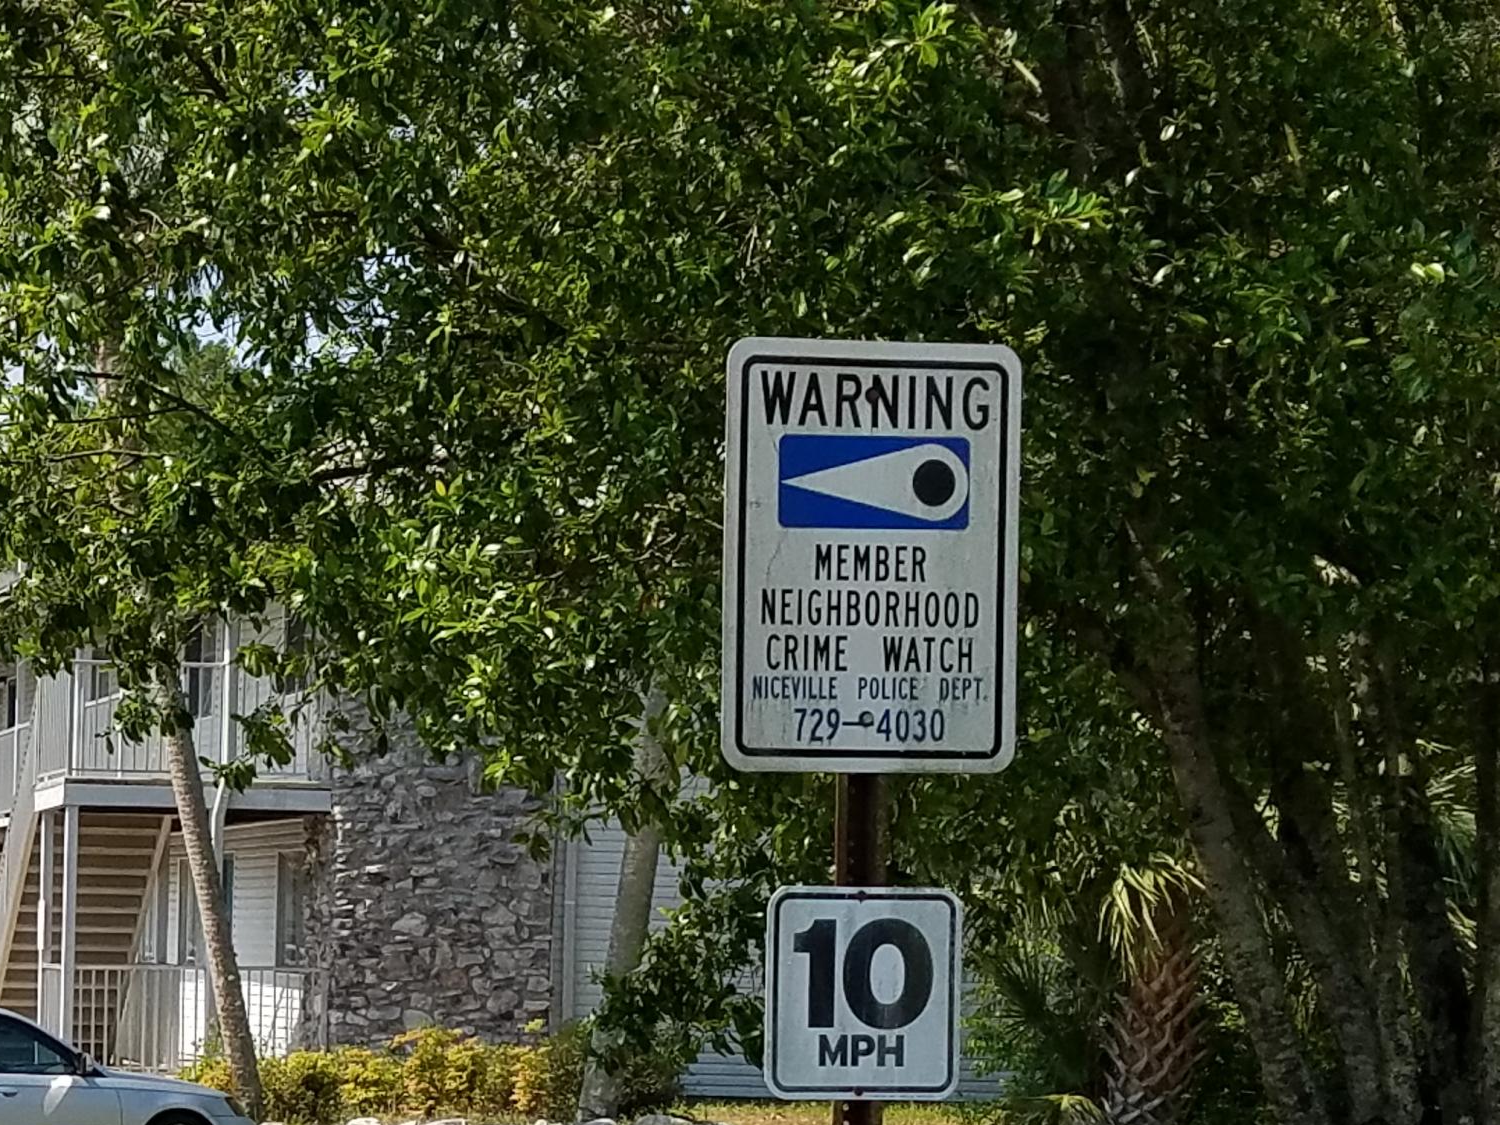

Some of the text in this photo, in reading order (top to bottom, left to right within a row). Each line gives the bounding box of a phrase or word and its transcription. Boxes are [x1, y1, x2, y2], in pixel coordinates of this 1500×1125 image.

[760, 370, 990, 431] WARNING
[814, 543, 927, 583] MEMBER
[760, 588, 979, 629] NEIGHBORHOOD
[766, 634, 973, 673] CRIME WATCH
[752, 675, 838, 700] NICEVILLE
[857, 676, 919, 700] POLICE
[794, 708, 945, 742] 729-4030
[793, 918, 934, 1030] 10
[818, 1034, 905, 1067] MPH
